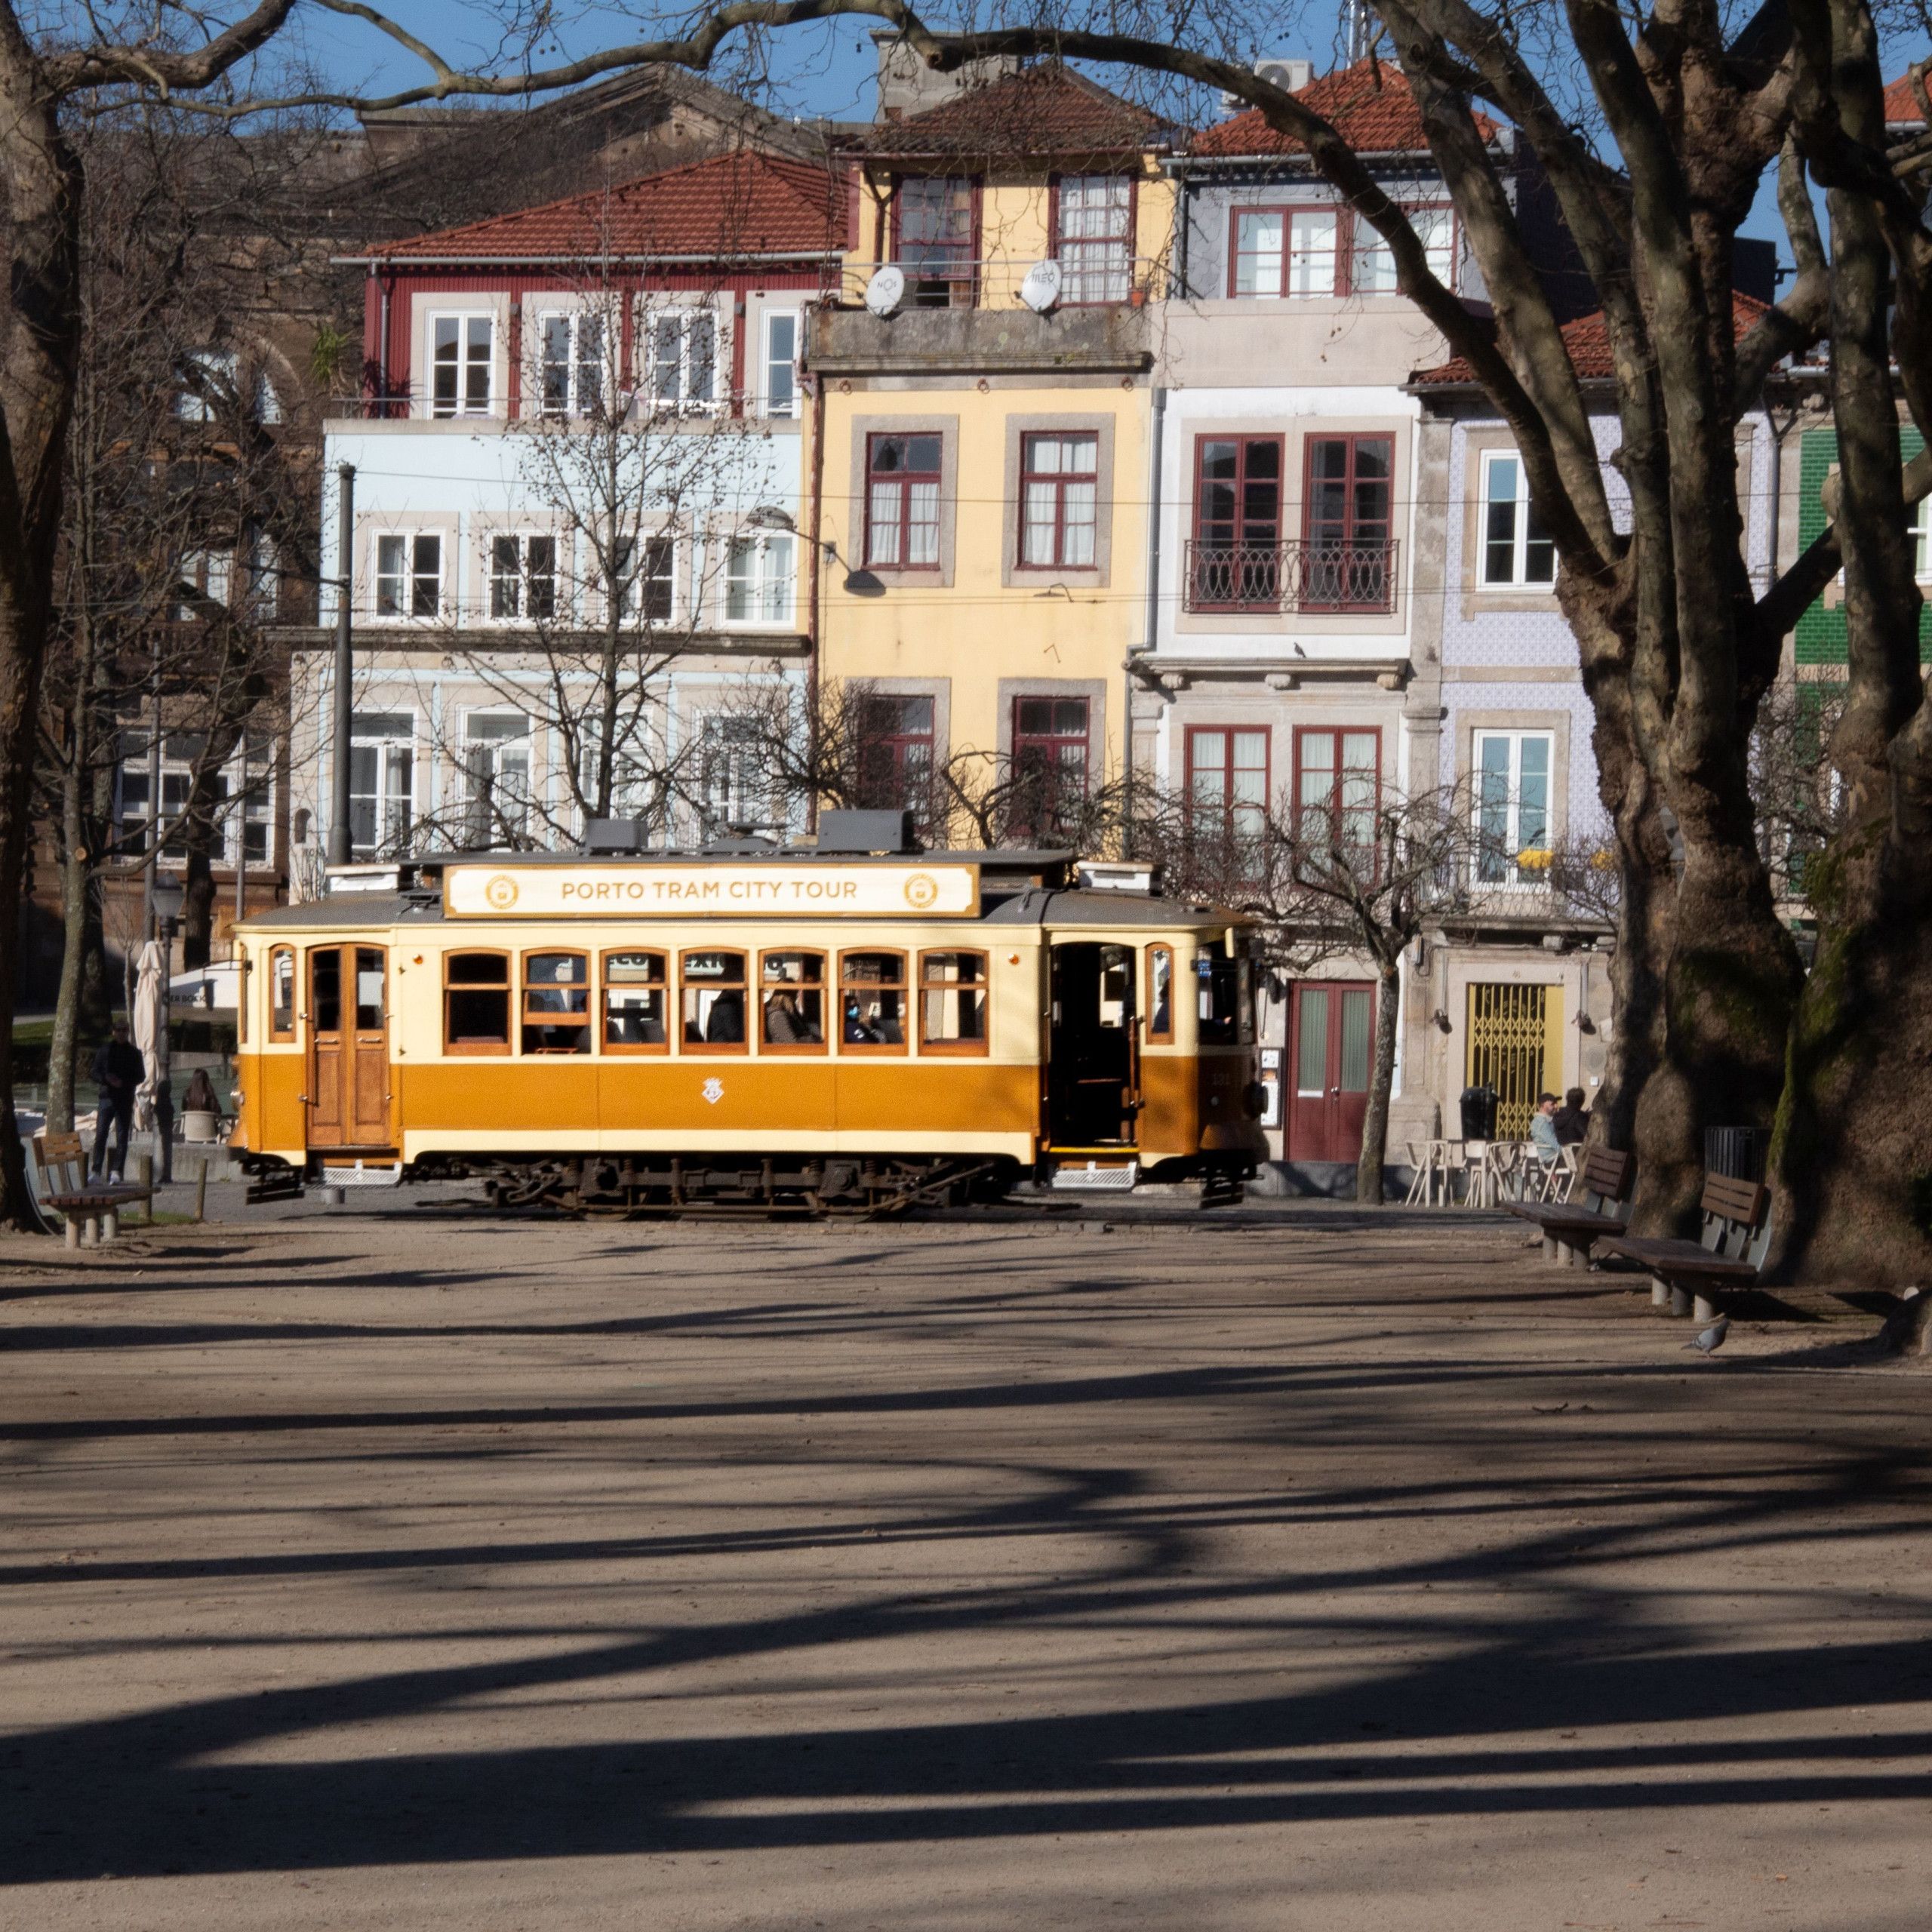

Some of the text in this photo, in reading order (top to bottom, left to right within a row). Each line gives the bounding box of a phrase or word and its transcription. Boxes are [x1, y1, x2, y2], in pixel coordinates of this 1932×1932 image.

[561, 881, 857, 900] PORTO TRAM CITY TOUR
